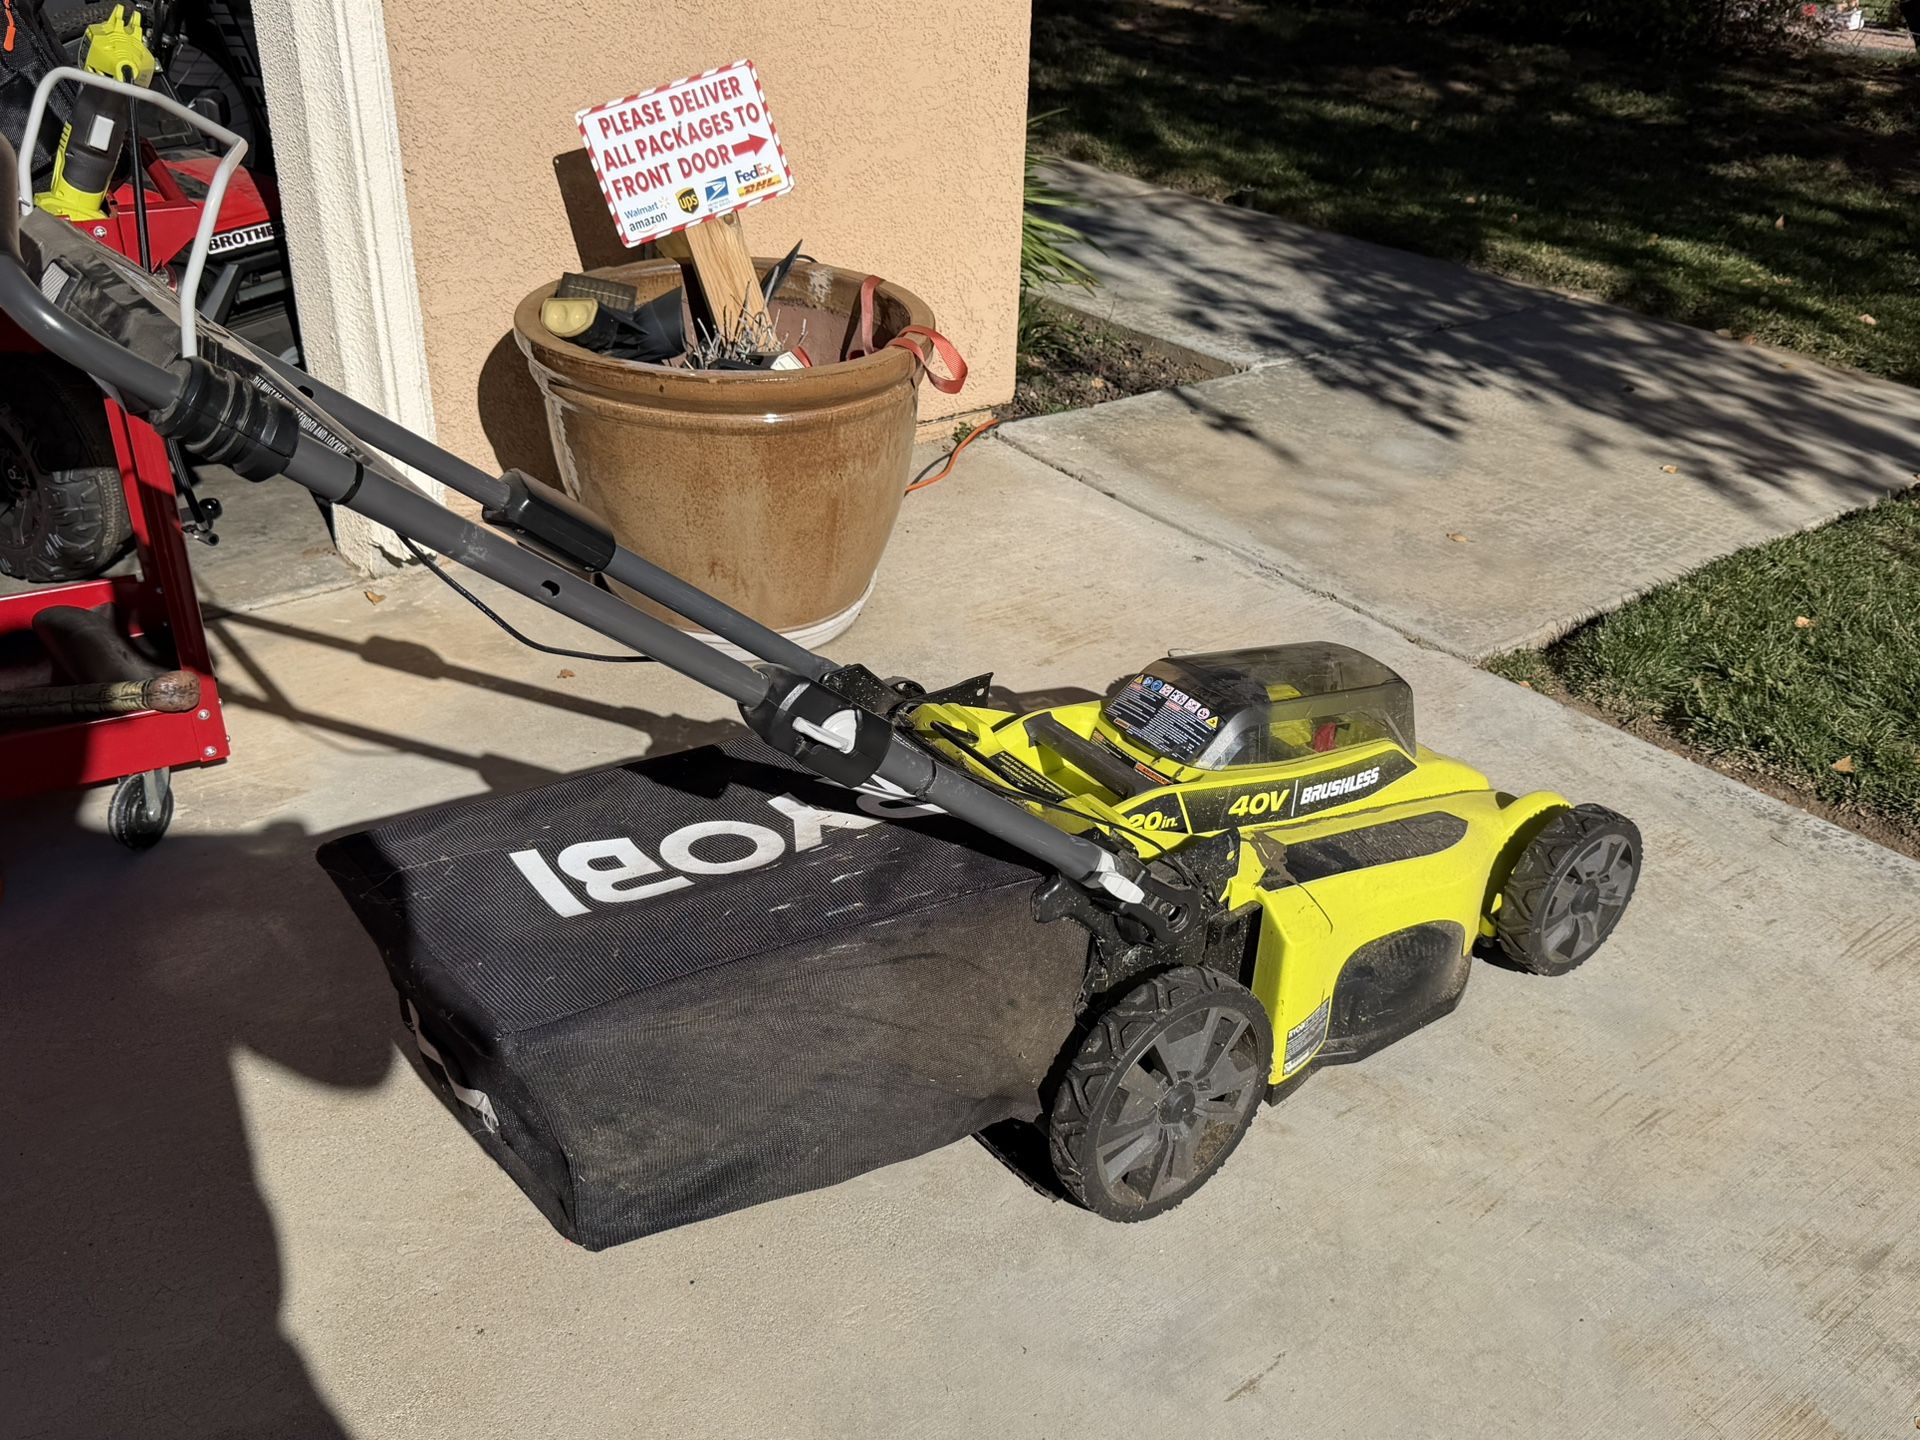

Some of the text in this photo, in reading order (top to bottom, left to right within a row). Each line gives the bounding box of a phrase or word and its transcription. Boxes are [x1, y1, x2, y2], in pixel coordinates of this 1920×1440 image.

[598, 76, 743, 139] PLEASE DELIVER
[603, 102, 760, 172] ALL PACKAGES TO
[611, 144, 732, 201] FRONT DOOR
[735, 163, 773, 183] FedEx
[744, 178, 776, 195] DHL
[624, 201, 659, 219] Walmart
[678, 194, 698, 212] ups
[629, 212, 667, 232] amazon
[1229, 768, 1379, 816] 40V BRUSHLESS
